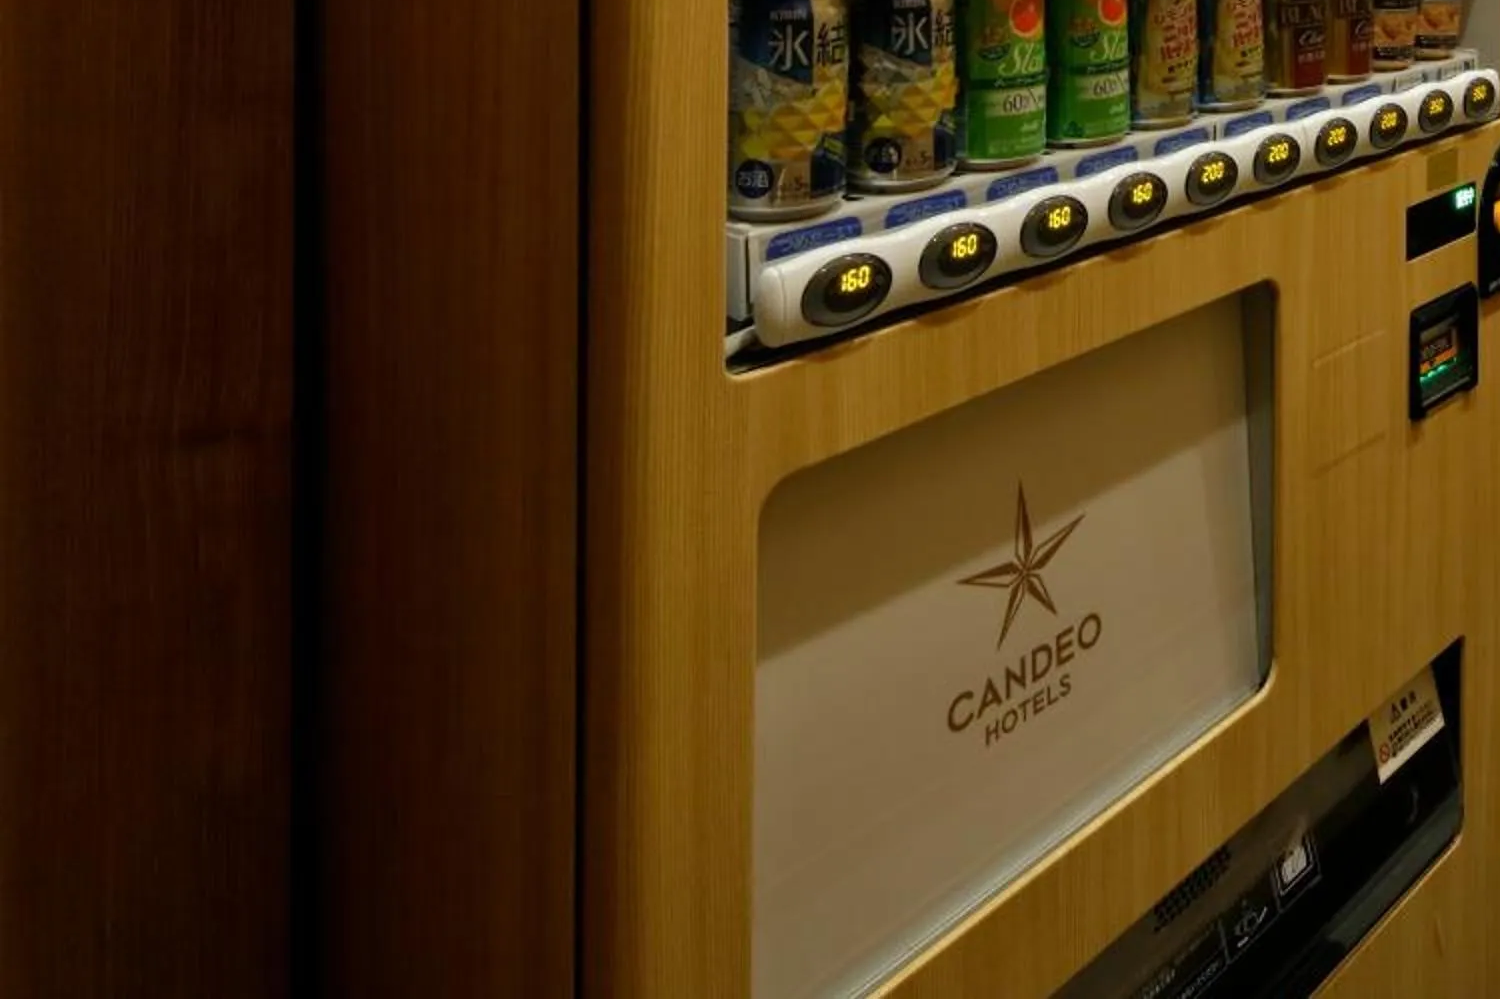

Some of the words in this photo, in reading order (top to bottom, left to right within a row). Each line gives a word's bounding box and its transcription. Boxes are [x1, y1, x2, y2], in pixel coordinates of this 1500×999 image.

[1132, 182, 1153, 204] 160
[1049, 206, 1071, 229] 160
[952, 233, 977, 258] 160
[841, 265, 870, 292] 160
[947, 612, 1102, 732] CANDEO
[985, 673, 1072, 746] HOTELS
